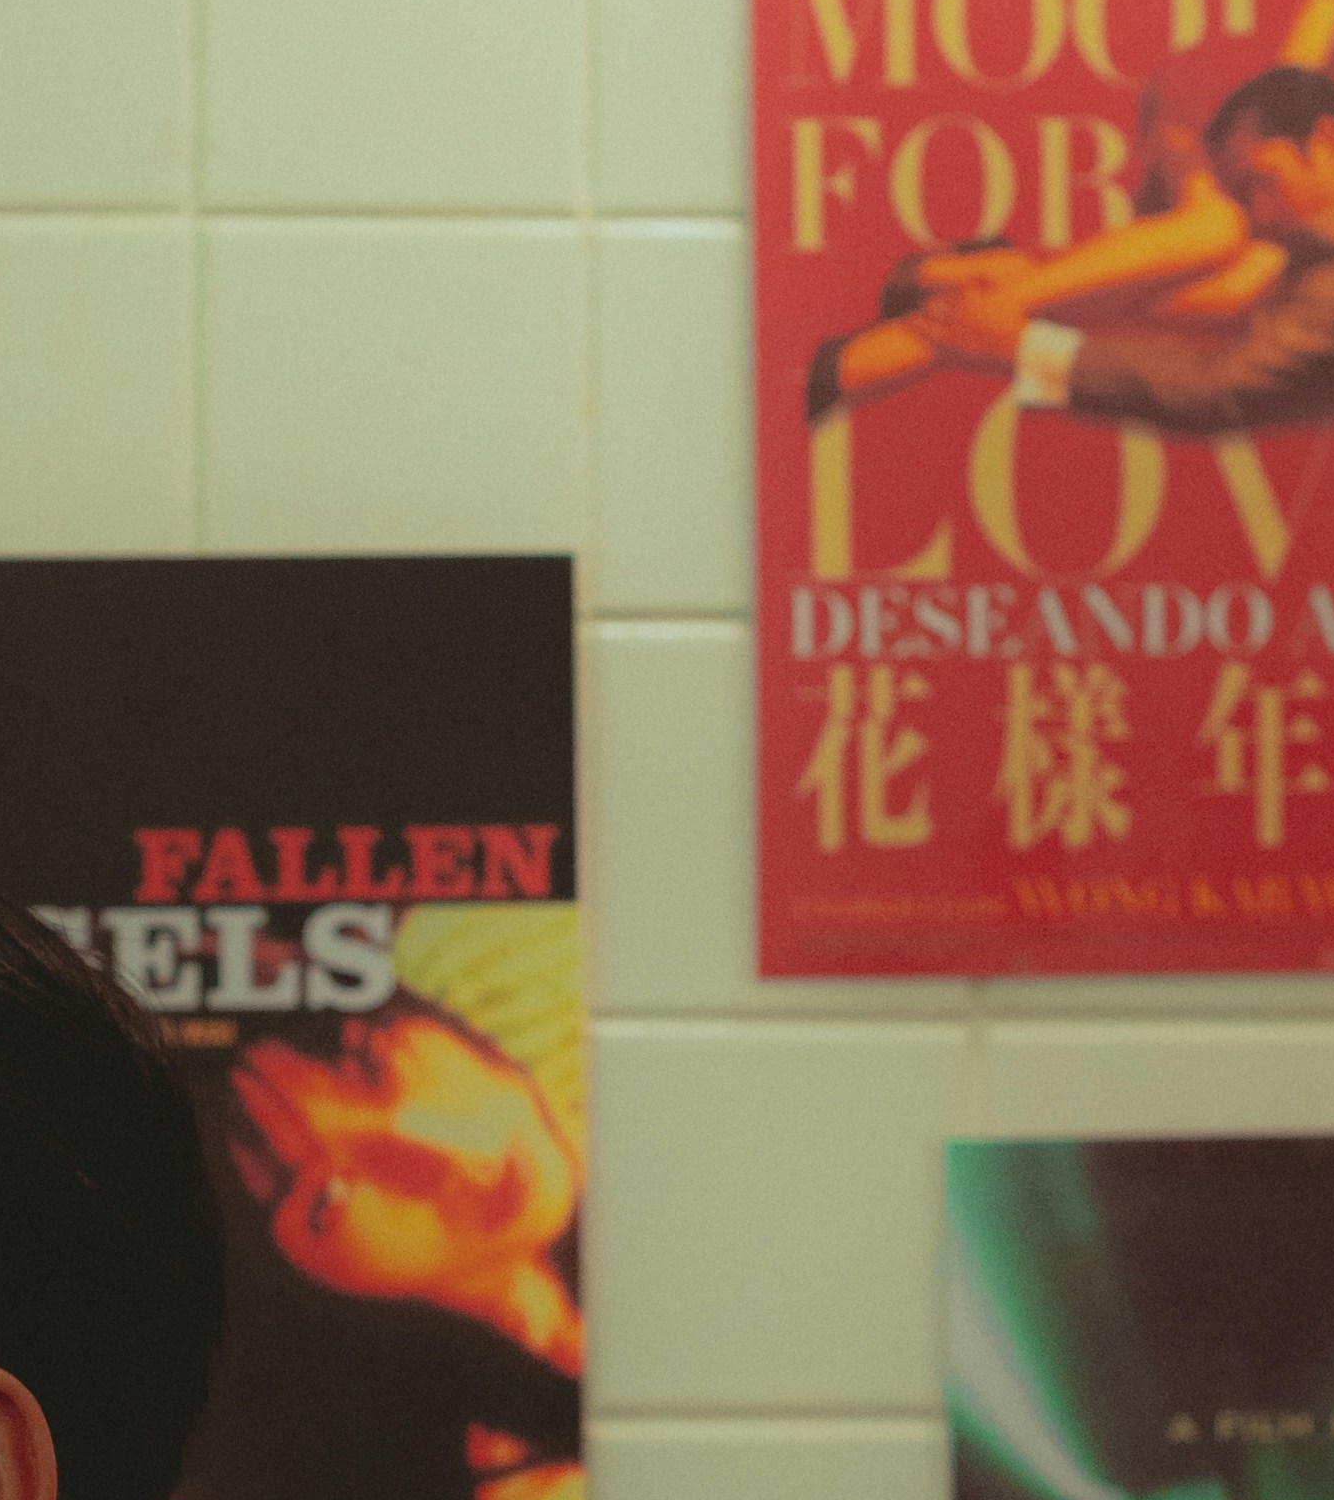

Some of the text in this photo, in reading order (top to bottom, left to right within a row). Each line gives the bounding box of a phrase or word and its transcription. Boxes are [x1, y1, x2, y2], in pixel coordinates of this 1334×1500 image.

[784, 112, 1135, 252] FOR
[789, 582, 1274, 659] DESEANDO
[133, 824, 560, 901] FALLEN
[29, 903, 399, 1012] ELS
